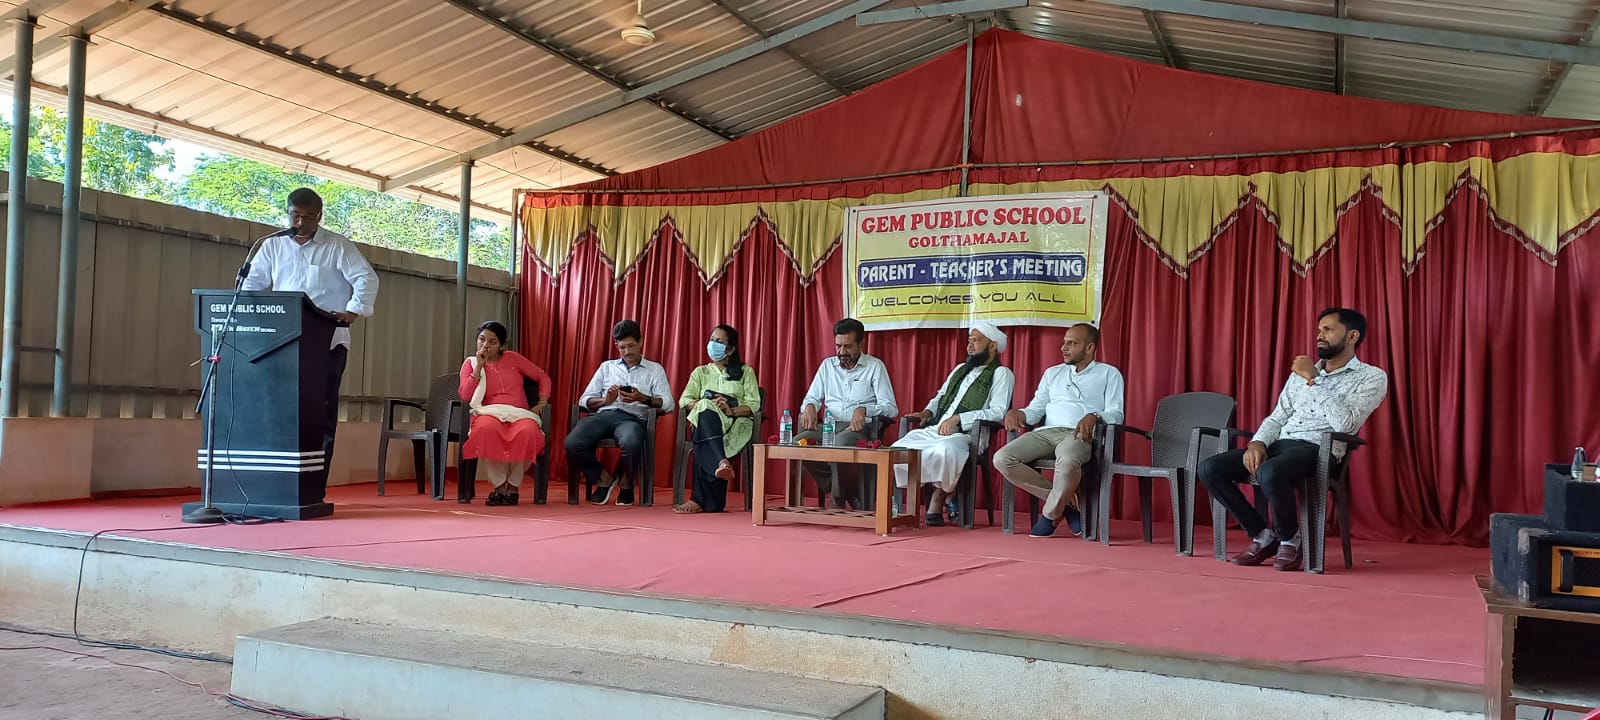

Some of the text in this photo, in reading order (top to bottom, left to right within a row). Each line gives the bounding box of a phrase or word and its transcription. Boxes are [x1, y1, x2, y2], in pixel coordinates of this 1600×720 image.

[861, 206, 1086, 234] GEM PUBLIC SCHOOL
[908, 231, 1030, 249] GOLTHAMAJAL
[861, 263, 916, 283] PARENT
[930, 258, 1008, 281] TEACHER'S
[1012, 259, 1082, 276] MEETING
[871, 291, 1065, 307] WELCOMES YOU ALL
[210, 304, 227, 313] GEM
[255, 305, 286, 314] SCHOOL
